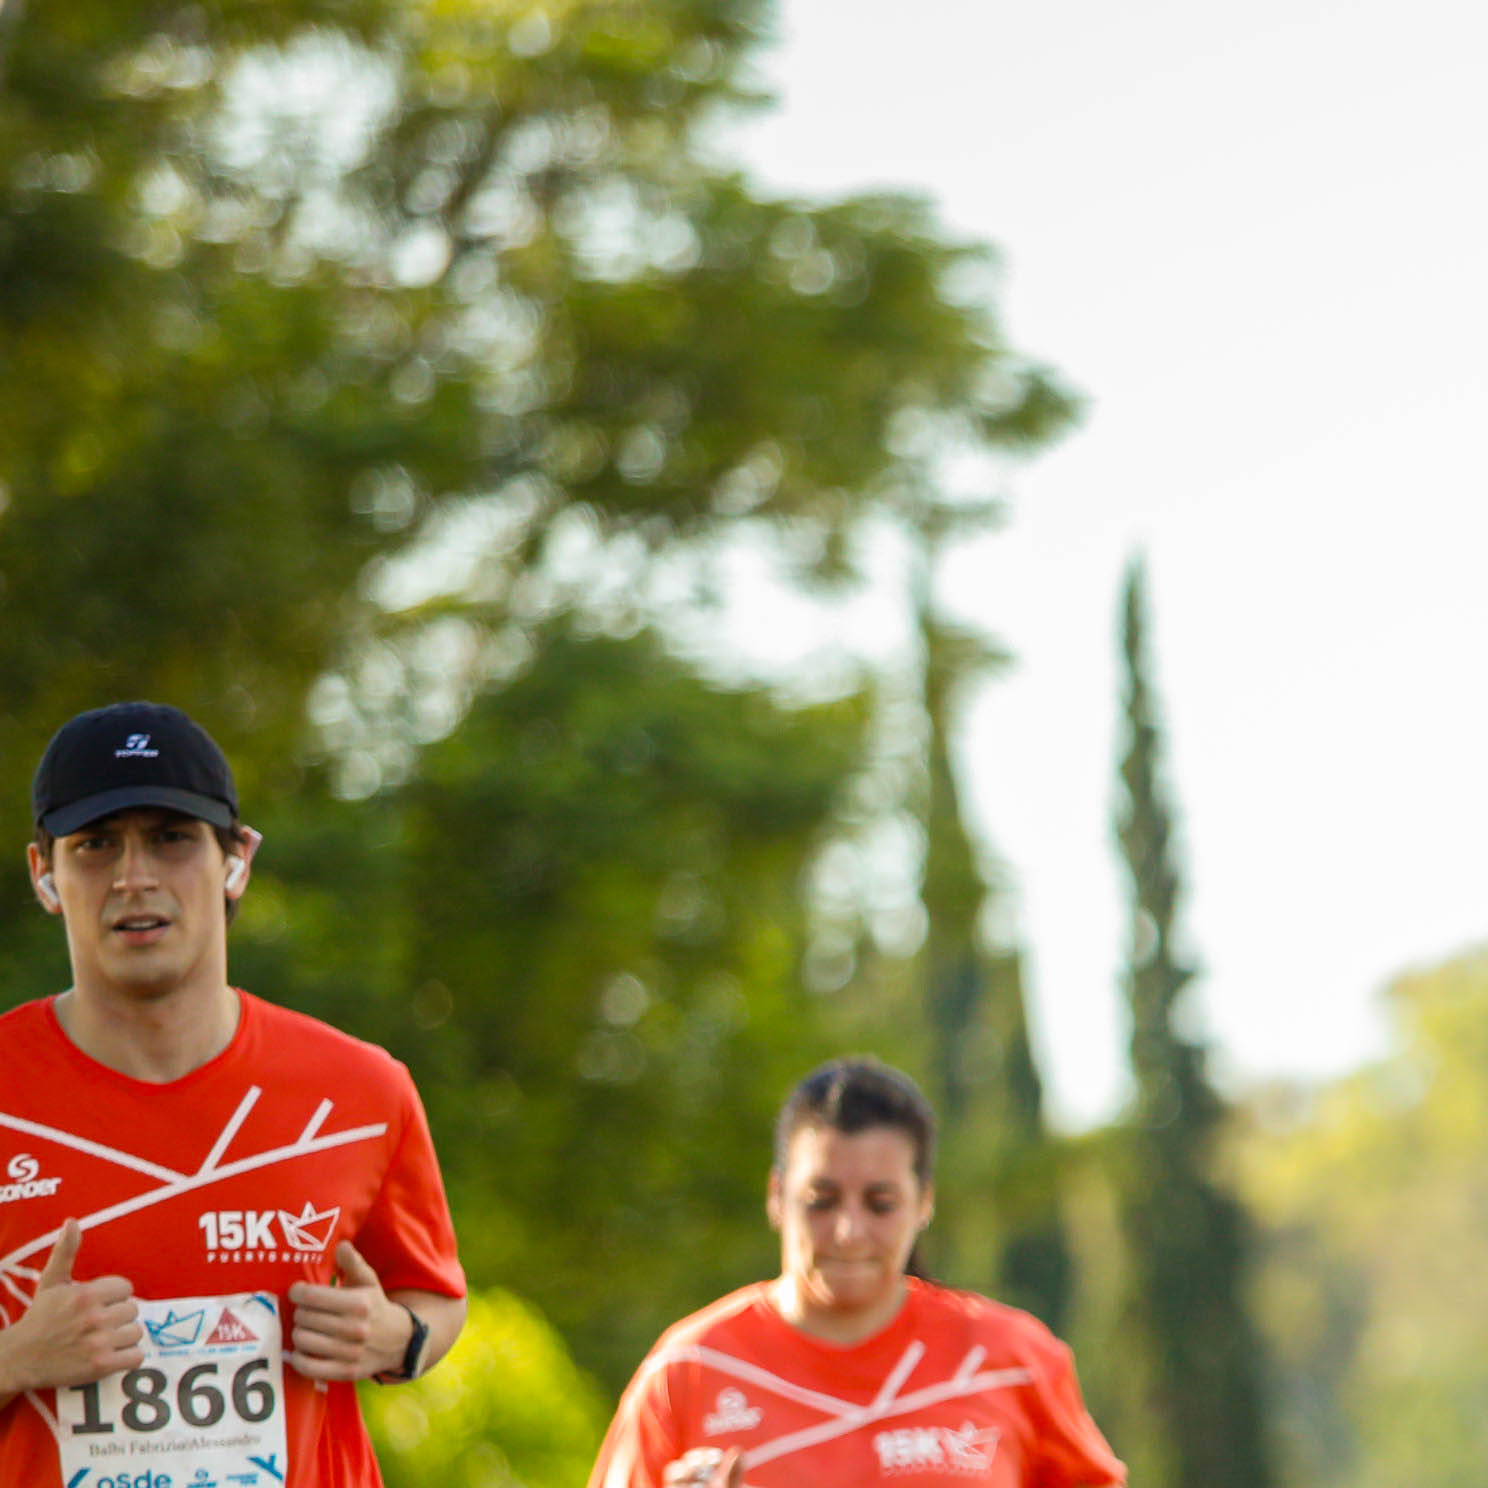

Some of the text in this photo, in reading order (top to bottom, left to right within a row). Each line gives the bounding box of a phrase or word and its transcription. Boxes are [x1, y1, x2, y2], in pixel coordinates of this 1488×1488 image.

[198, 1210, 278, 1250] 15K
[207, 1251, 277, 1263] PUERTO
[68, 1357, 275, 1434] 1866
